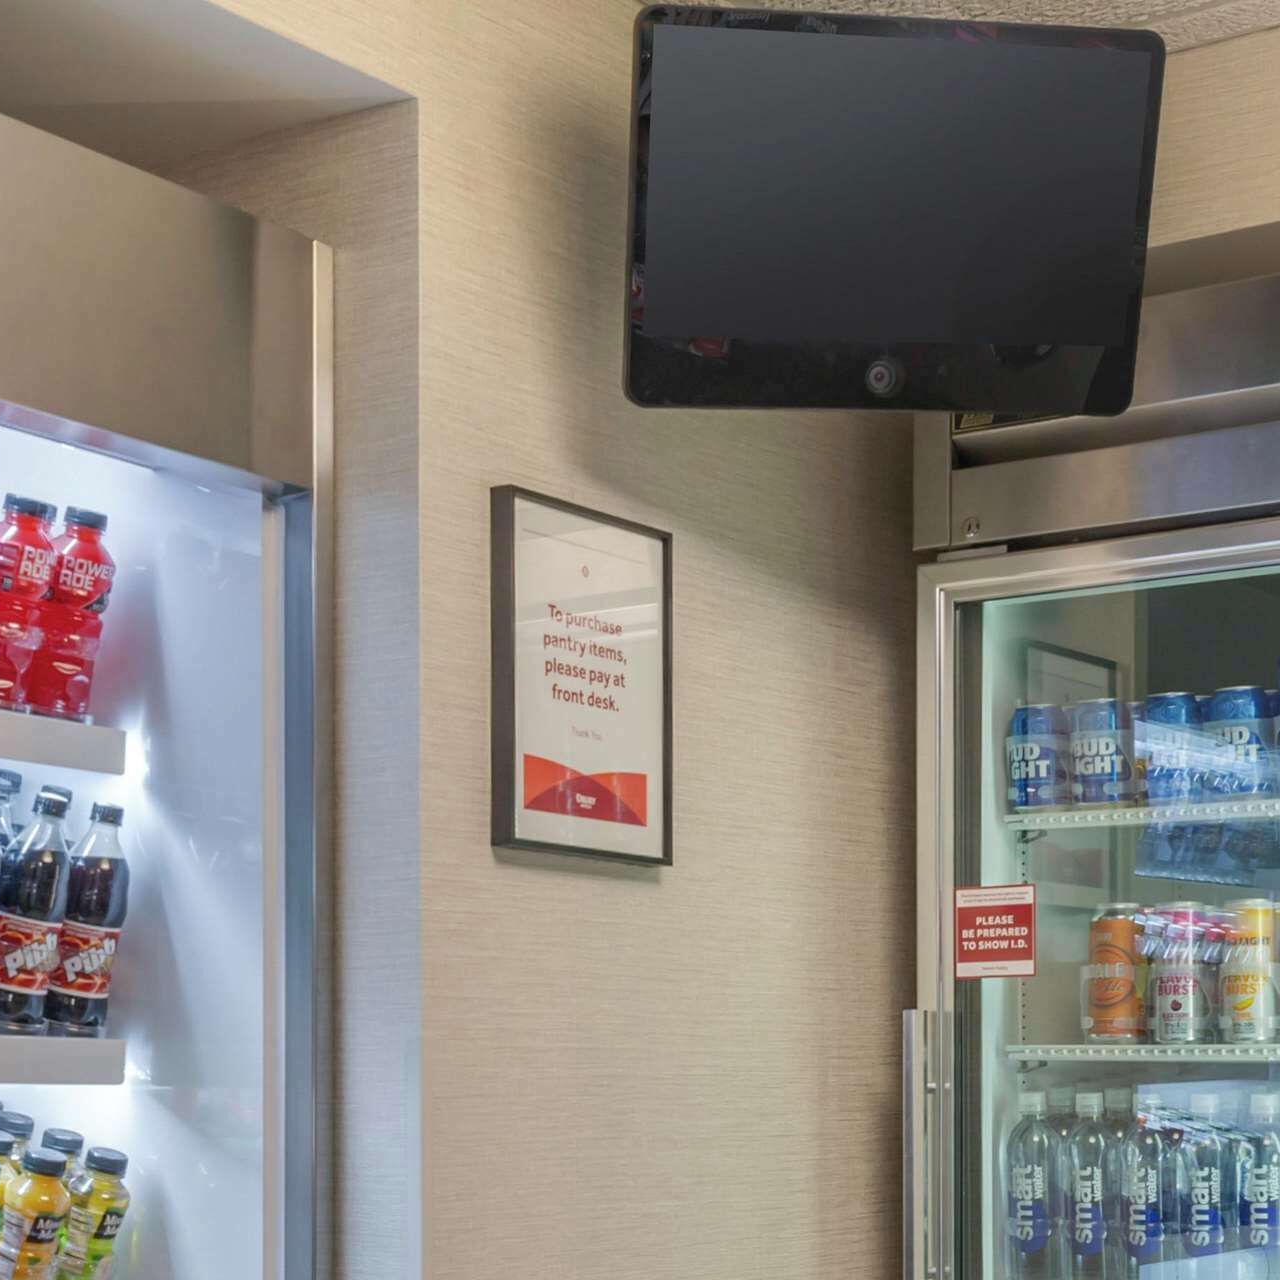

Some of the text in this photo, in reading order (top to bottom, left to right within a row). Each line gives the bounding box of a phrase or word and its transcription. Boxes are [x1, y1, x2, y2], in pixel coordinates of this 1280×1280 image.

[60, 570, 95, 592] ADE
[548, 604, 623, 637] To purchase
[543, 633, 628, 665] pantry items,
[545, 657, 626, 689] please pay at
[552, 683, 620, 712] front desk.
[1075, 755, 1124, 775] IGHT
[962, 927, 1028, 938] BE PREPARED
[976, 915, 1014, 926] PLEASE
[963, 939, 1028, 950] TO SHOW I.D.
[1034, 1166, 1044, 1201] water
[1093, 1166, 1103, 1202] water
[1147, 1166, 1158, 1204] water
[1210, 1166, 1221, 1203] water
[1270, 1166, 1280, 1202] water
[1012, 1166, 1033, 1241] smart
[1075, 1166, 1094, 1245] smart
[1128, 1166, 1147, 1247] smart
[1191, 1165, 1211, 1247] smart
[1250, 1165, 1270, 1246] smart
